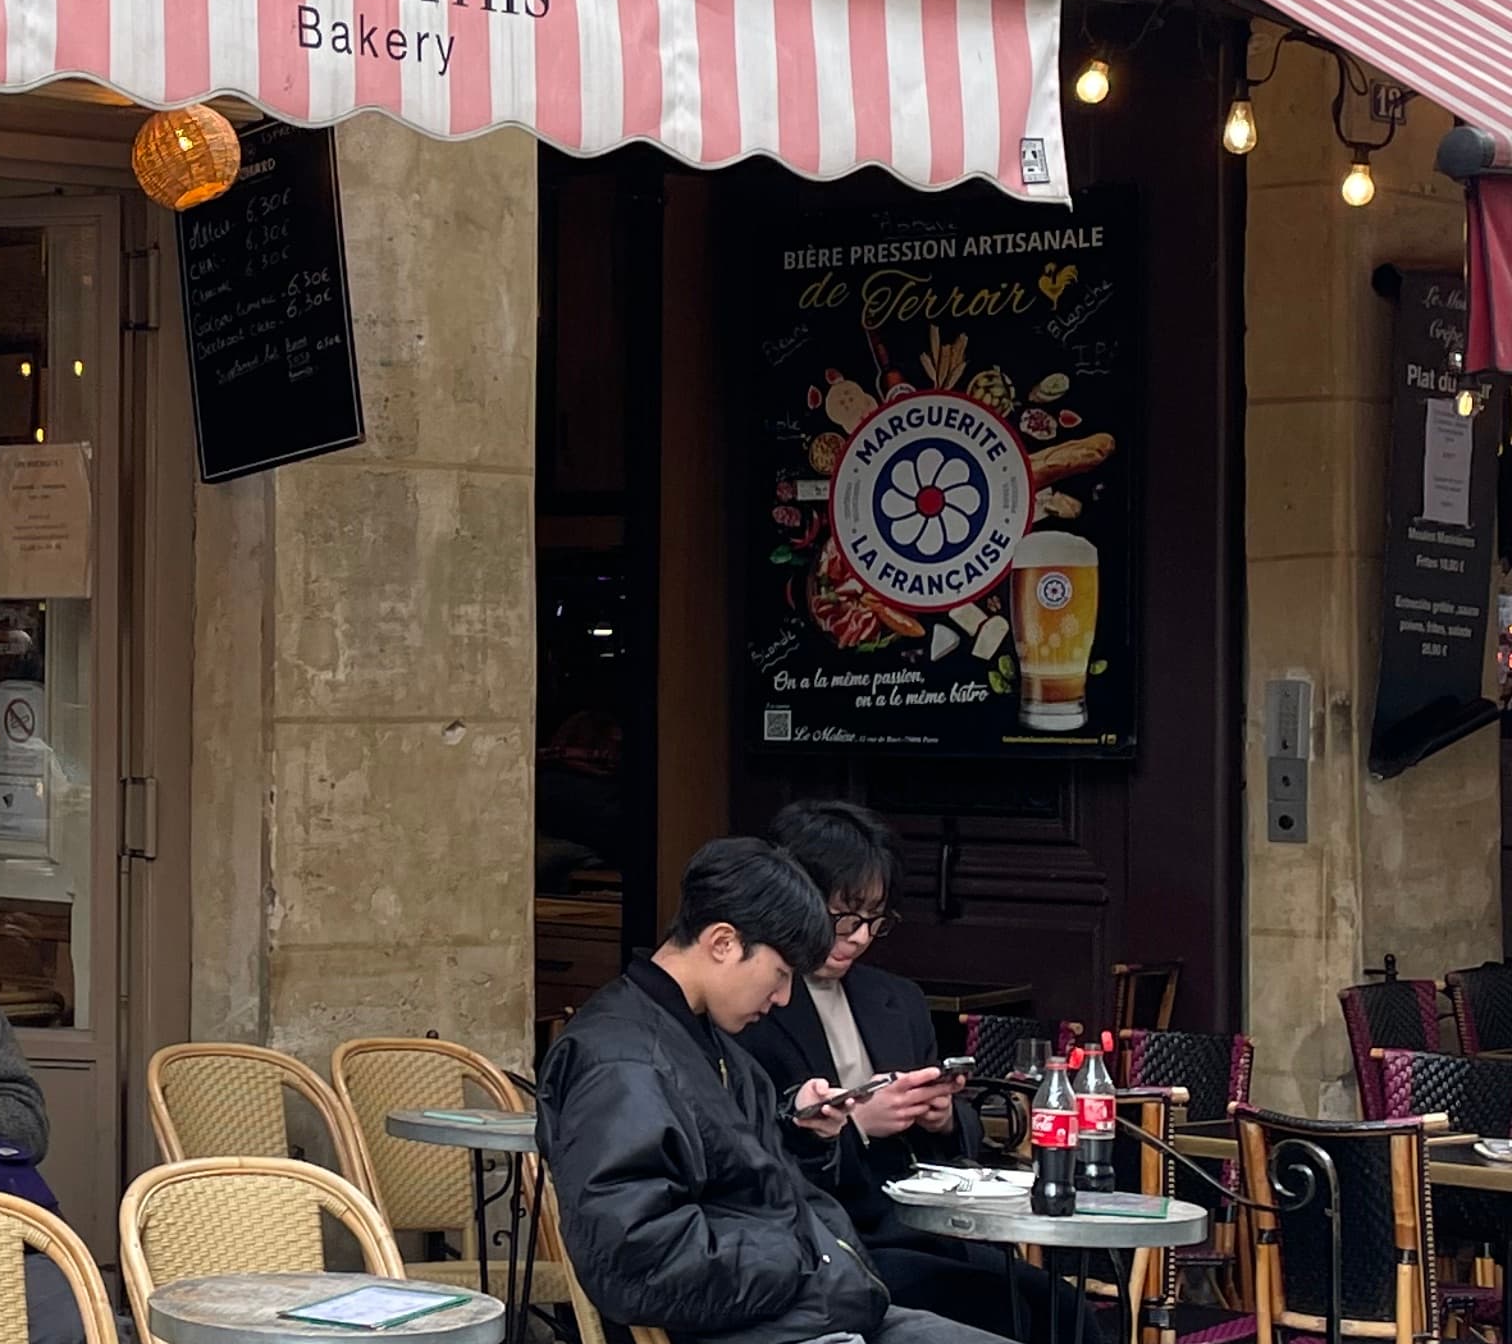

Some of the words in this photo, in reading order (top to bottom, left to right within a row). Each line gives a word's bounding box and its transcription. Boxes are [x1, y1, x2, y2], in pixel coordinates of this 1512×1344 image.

[298, 5, 455, 76] Bakery
[783, 245, 844, 271] BIÈRE
[849, 238, 957, 266] PRESSION
[962, 225, 1106, 258] ARTISANALE
[798, 271, 852, 310] de
[860, 268, 1038, 331] Terroir
[1407, 364, 1436, 391] Plat
[1438, 372, 1457, 393] du
[855, 405, 1007, 465] MARGUERITE
[851, 535, 878, 571] LA
[878, 529, 1011, 596] FRANÇAISE
[773, 670, 796, 692] On
[799, 677, 810, 689] a
[813, 667, 829, 689] la
[830, 671, 871, 689] même
[854, 693, 872, 709] on
[874, 693, 887, 708] a
[889, 685, 903, 707] le
[905, 689, 946, 707] même
[949, 680, 990, 705] bistro
